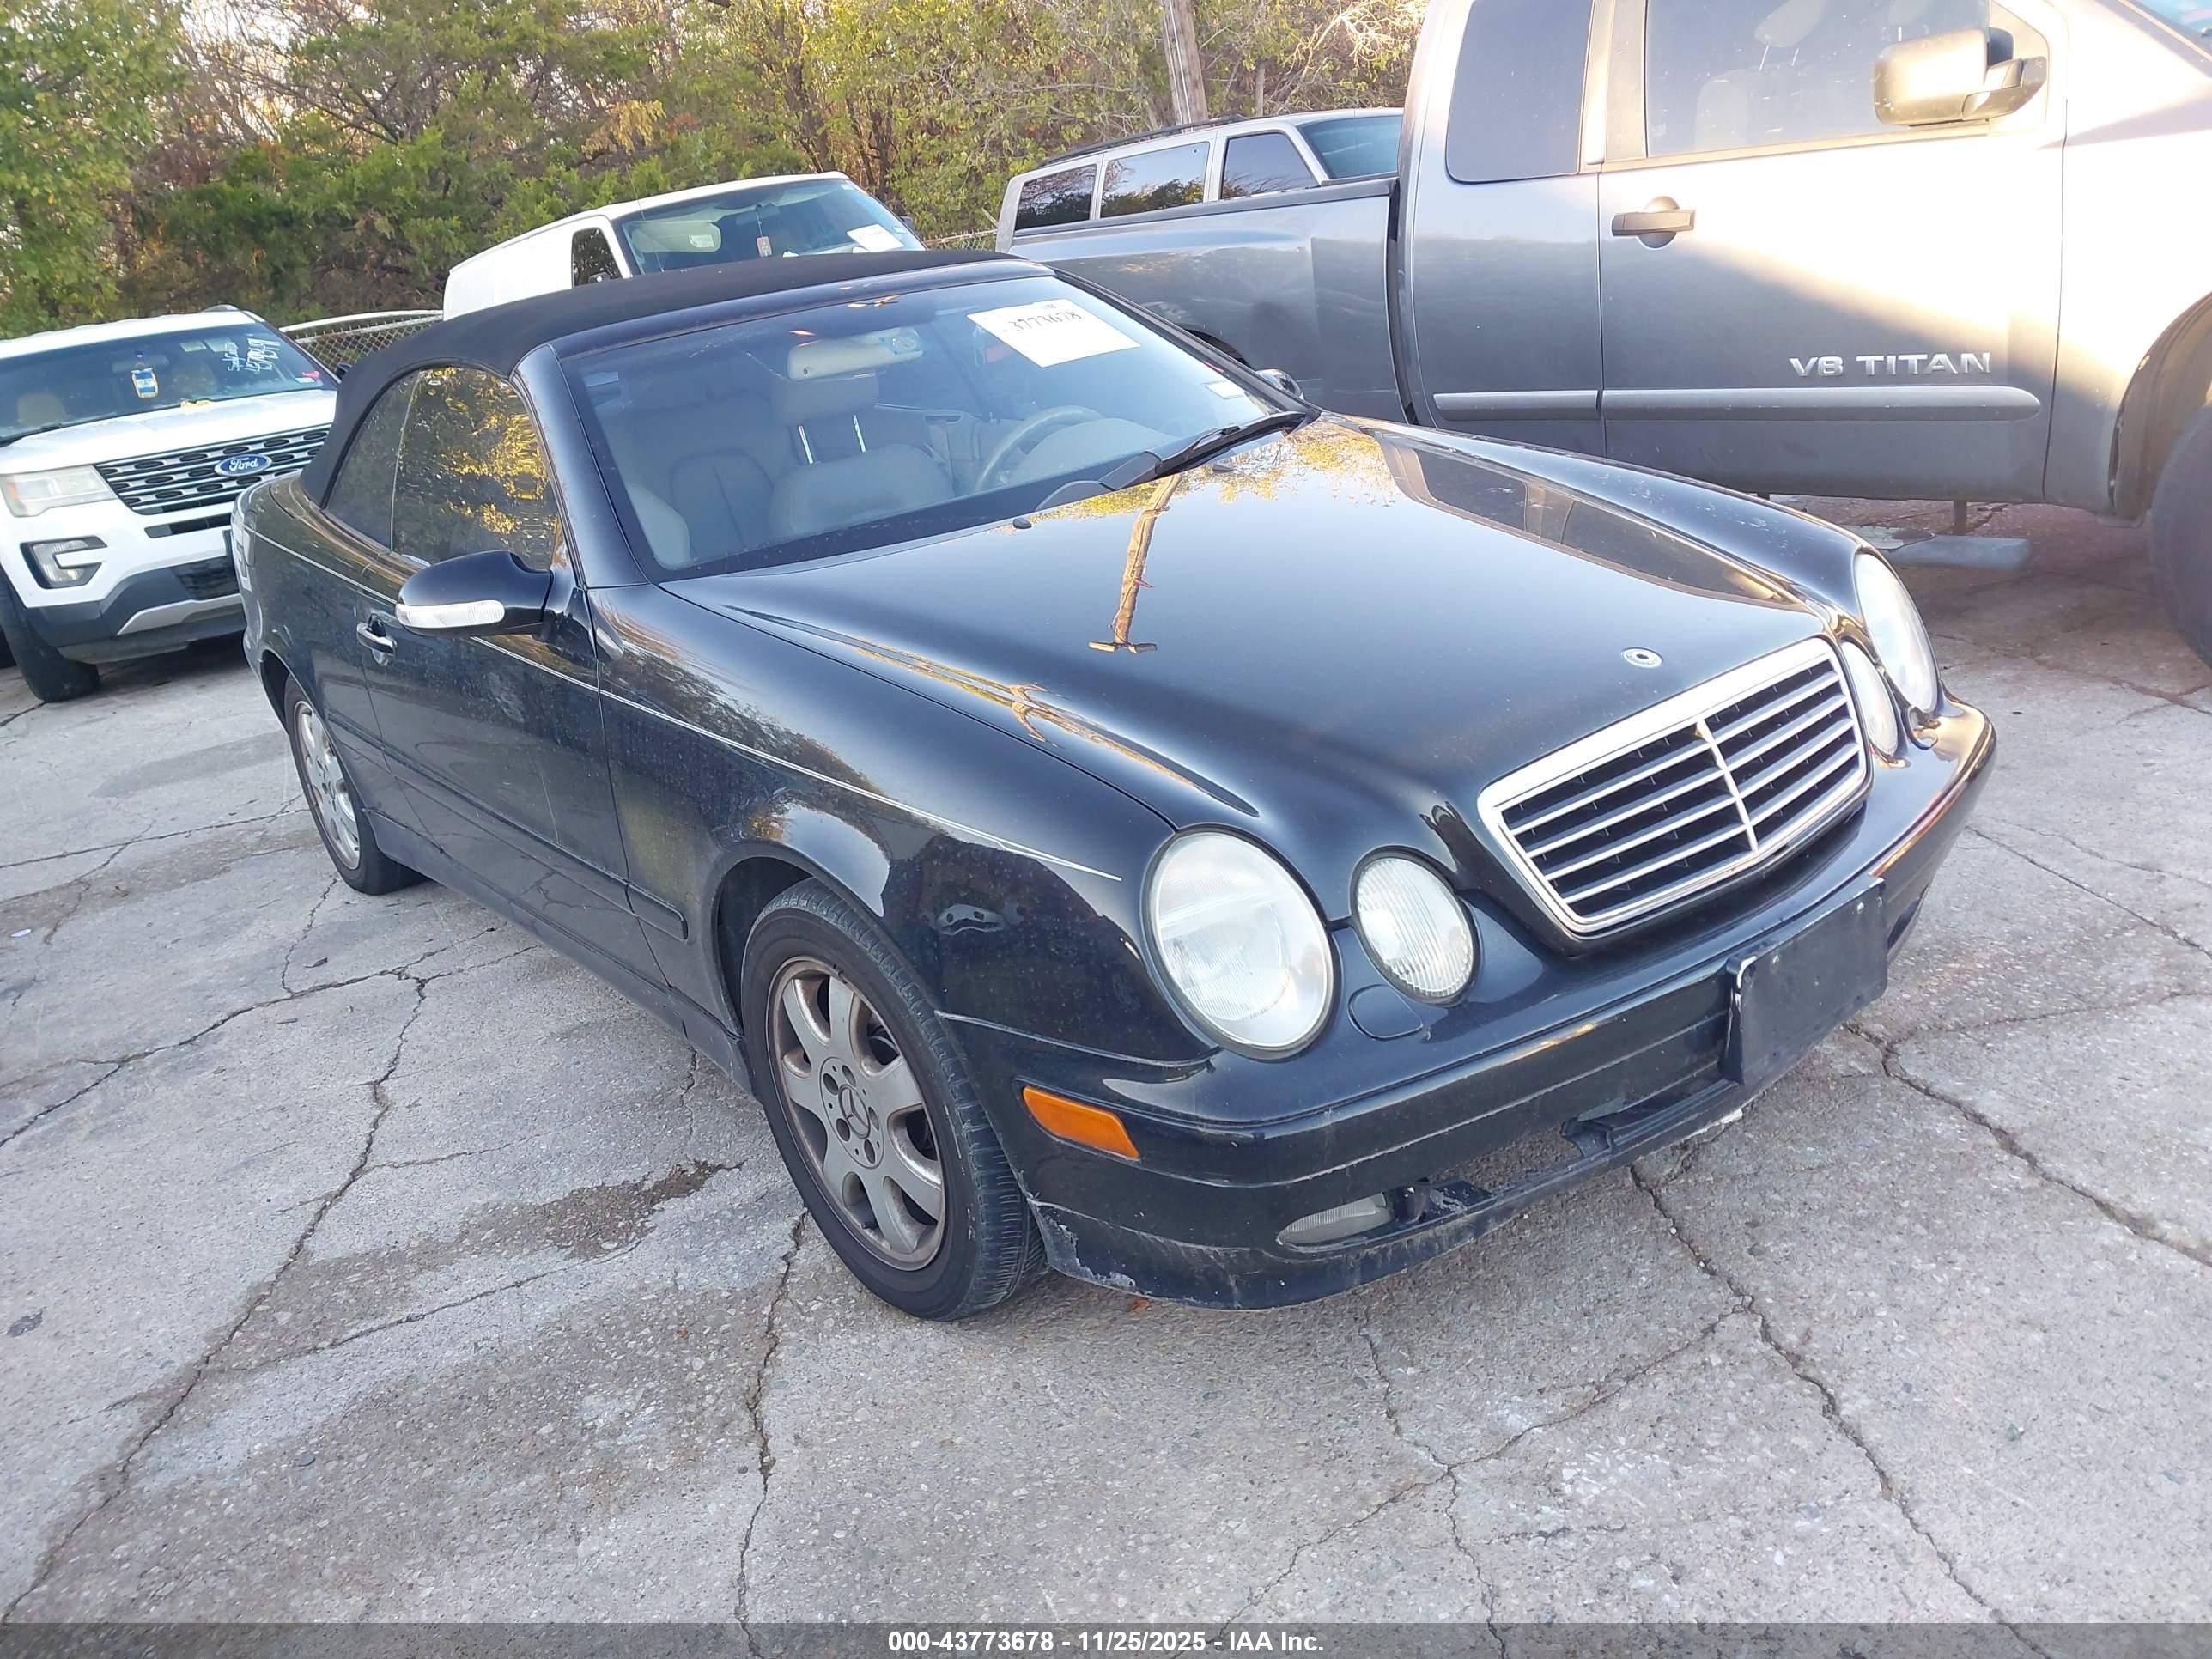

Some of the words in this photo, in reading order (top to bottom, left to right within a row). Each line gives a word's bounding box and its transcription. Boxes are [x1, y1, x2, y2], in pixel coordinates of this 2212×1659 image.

[1789, 356, 1844, 377] V8
[1855, 352, 1991, 376] TITAN
[228, 457, 259, 471] Ford
